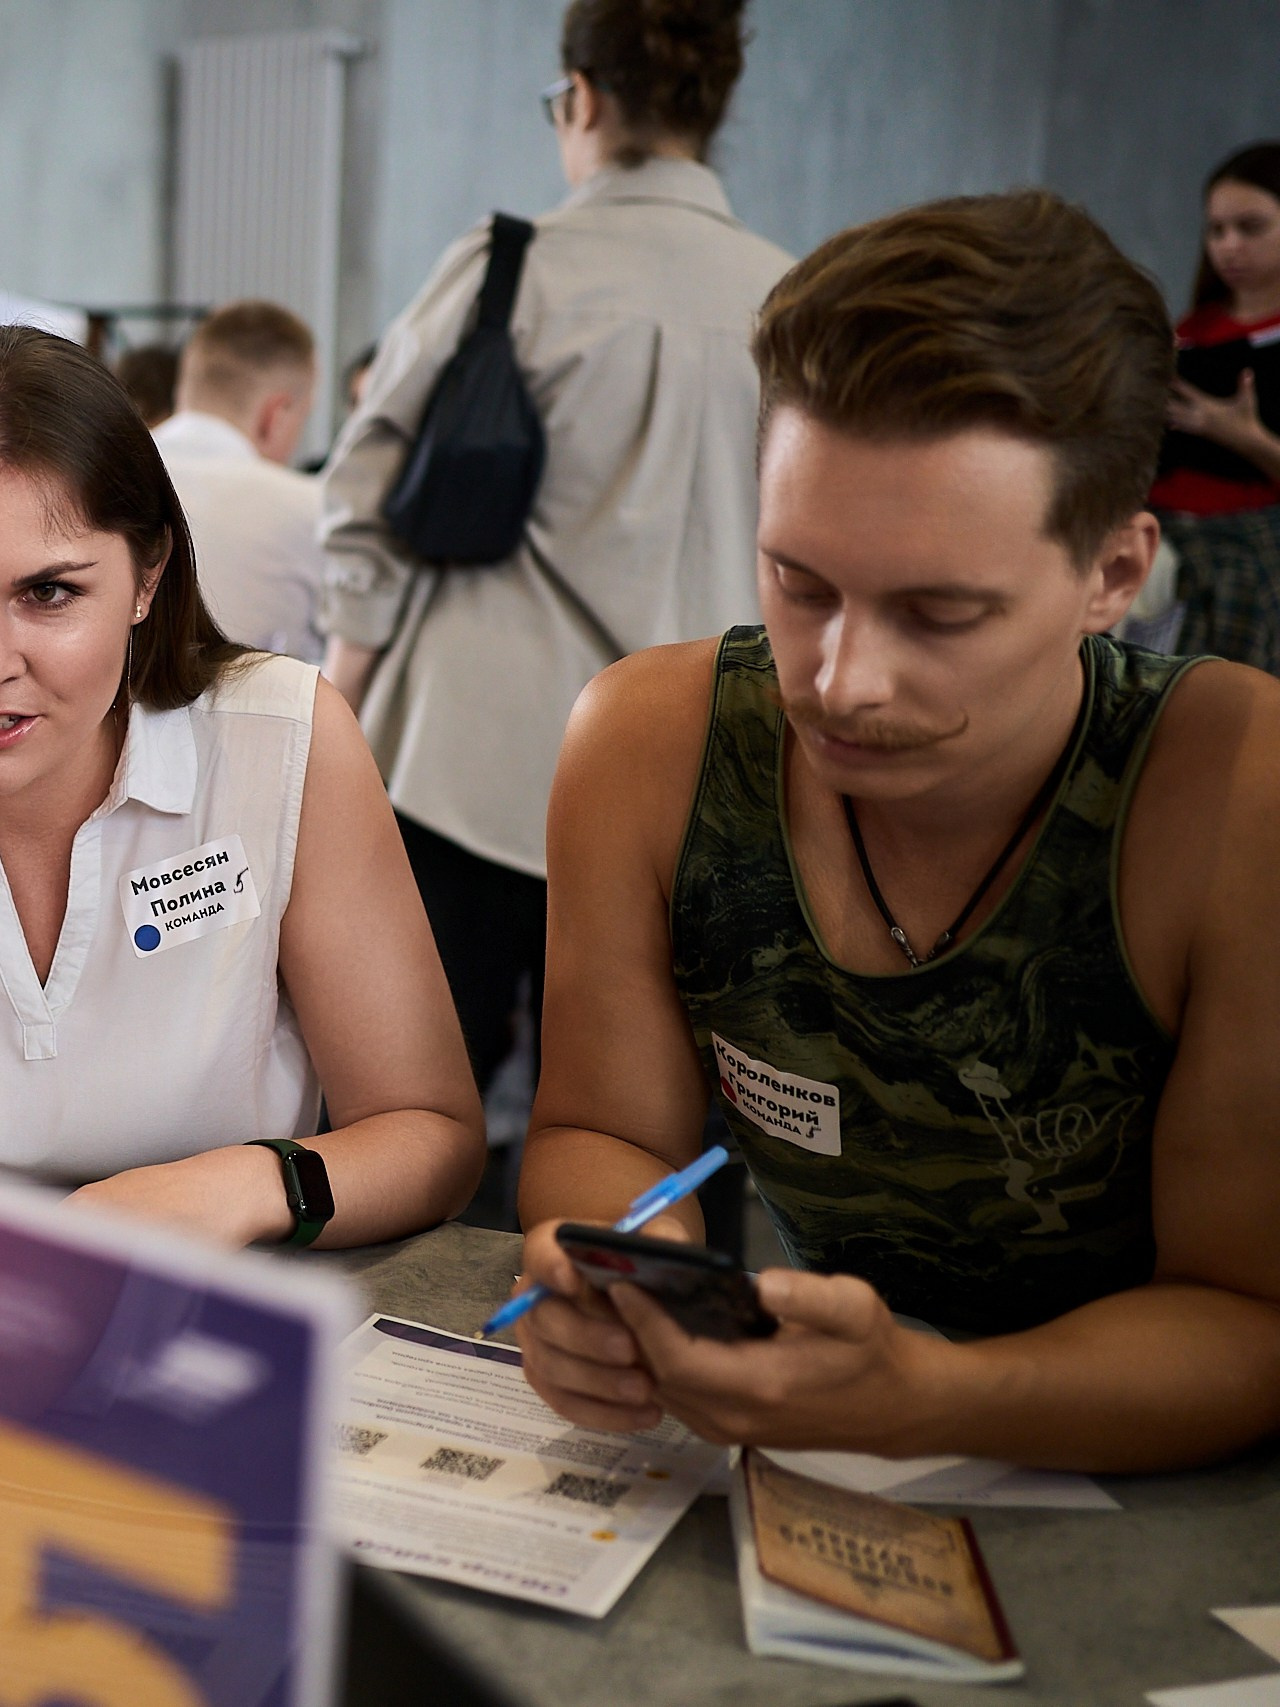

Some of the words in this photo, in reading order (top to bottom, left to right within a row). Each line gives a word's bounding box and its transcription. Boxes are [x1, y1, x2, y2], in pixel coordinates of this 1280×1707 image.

[130, 851, 229, 896] Мовсесян
[150, 881, 227, 917] Полина
[165, 902, 225, 931] КОМАНДА
[716, 1041, 836, 1107] Короленков
[728, 1071, 819, 1125] Григорий
[743, 1099, 801, 1135] КОМАНДА
